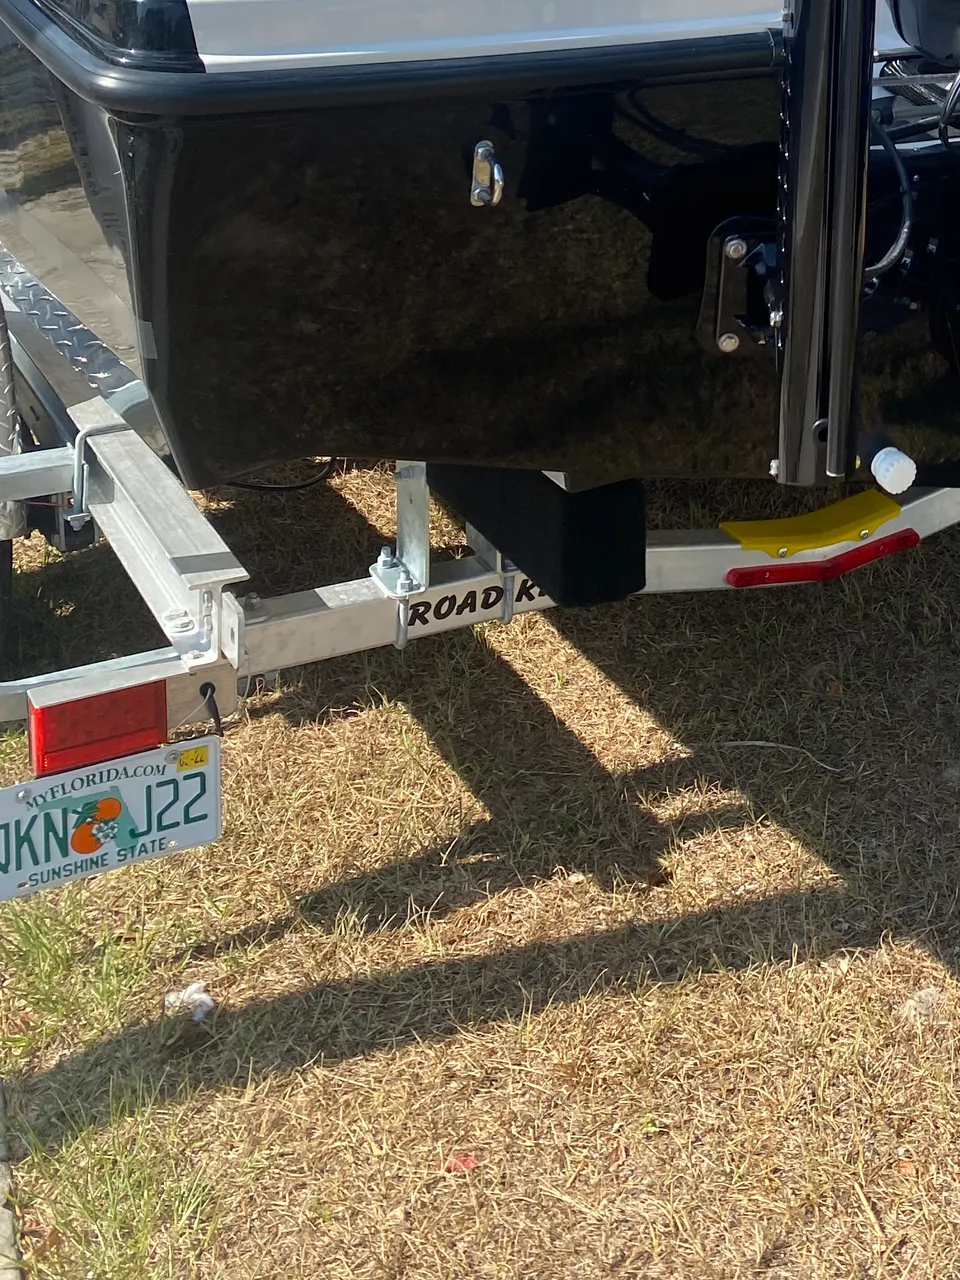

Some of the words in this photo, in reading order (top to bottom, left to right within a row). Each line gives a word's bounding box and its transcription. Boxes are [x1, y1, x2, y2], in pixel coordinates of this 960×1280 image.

[407, 585, 504, 627] ROAD
[515, 578, 549, 604] K
[25, 764, 167, 812] MYFLORIDA.COM
[129, 771, 208, 839] J22
[28, 852, 109, 888] SUNSHINE
[117, 836, 168, 863] STATE
